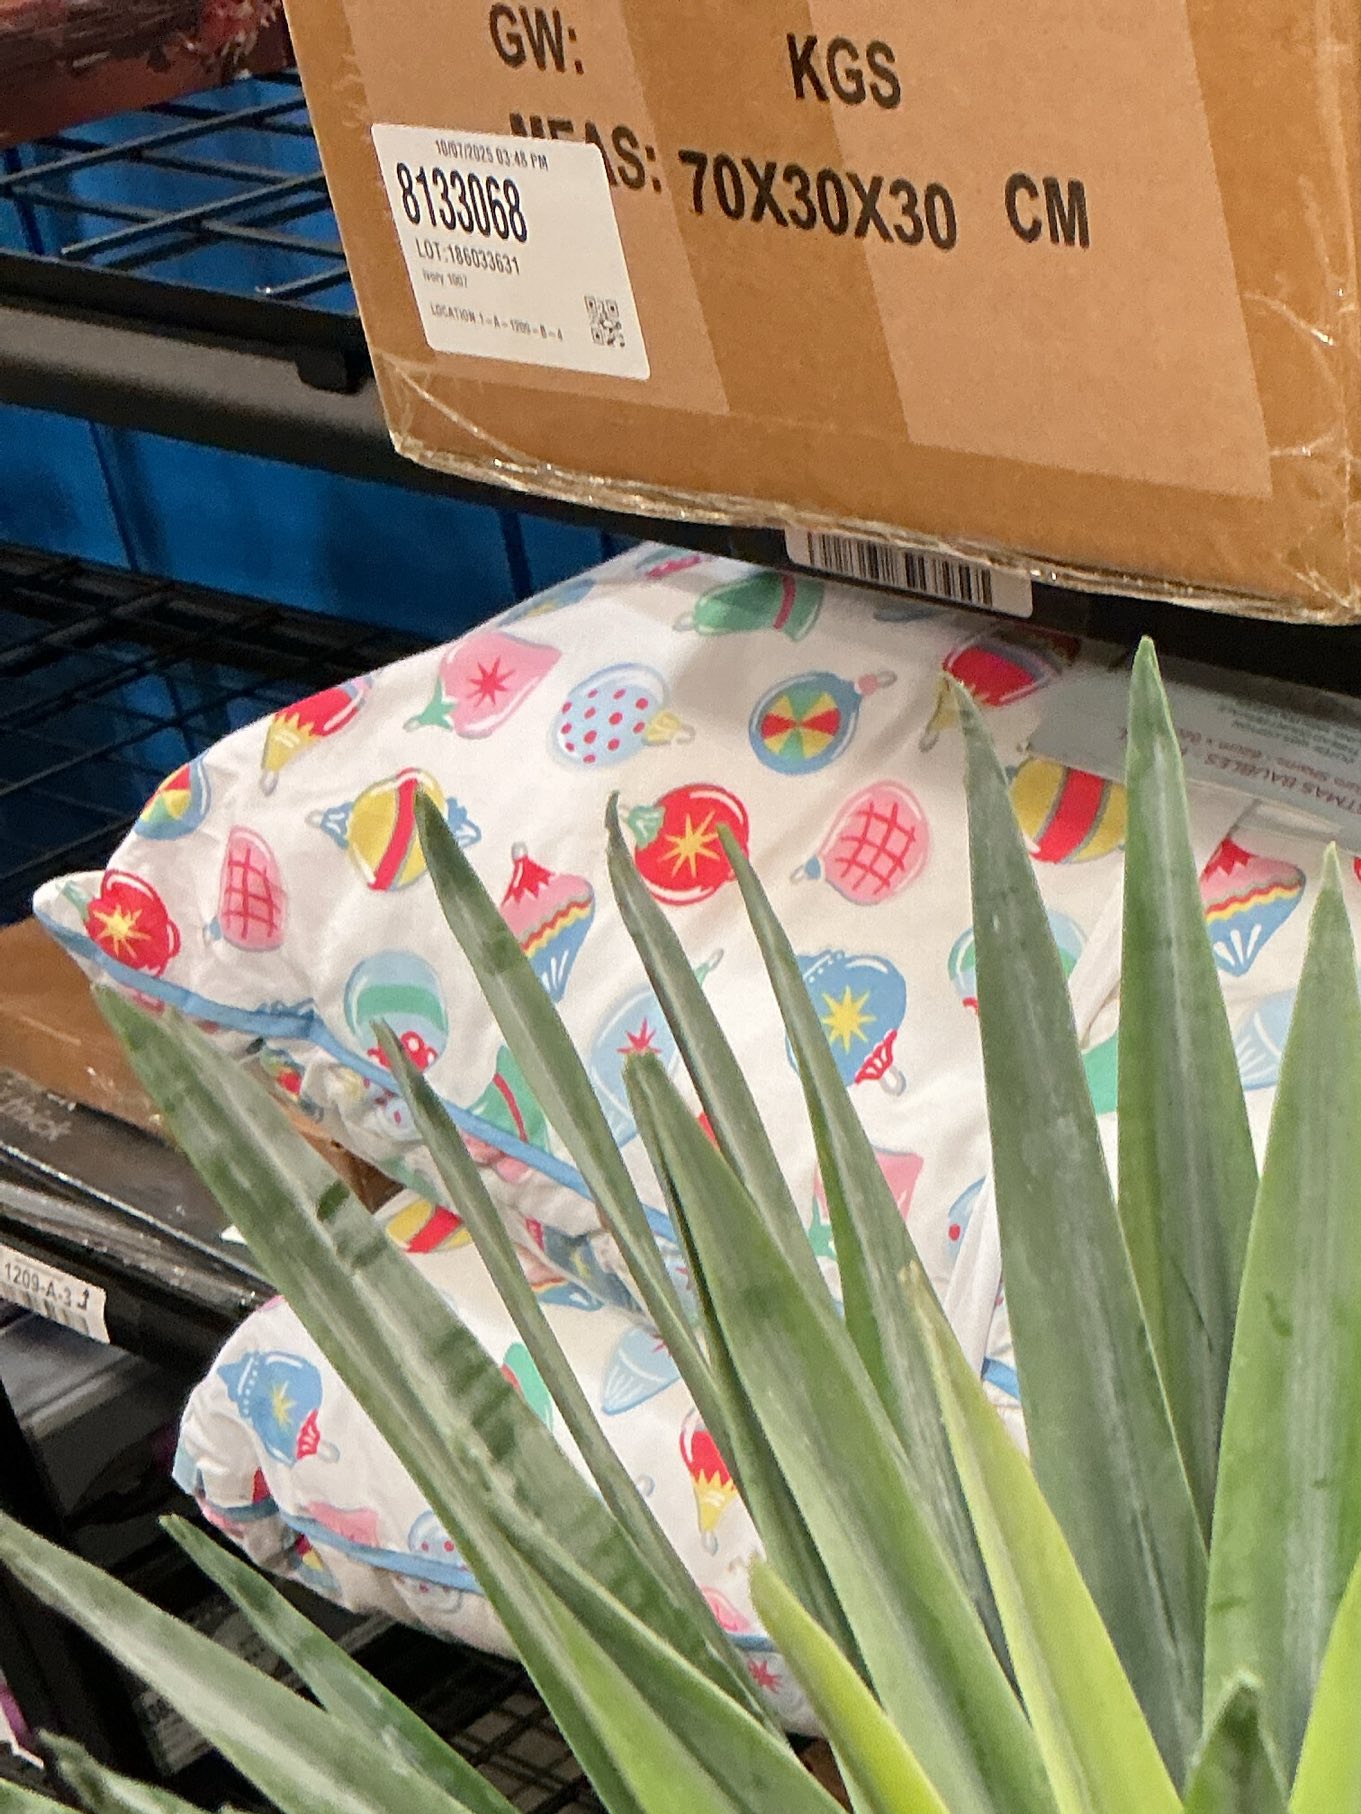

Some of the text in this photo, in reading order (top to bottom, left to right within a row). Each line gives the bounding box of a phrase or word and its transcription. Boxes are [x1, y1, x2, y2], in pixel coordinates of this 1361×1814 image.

[488, 1, 584, 75] GW:
[785, 32, 902, 109] KGS
[435, 139, 494, 164] 10/07/2025
[530, 153, 549, 171] PM
[396, 162, 528, 243] 8133068
[678, 149, 958, 251] 70X30X30
[1005, 172, 1091, 249] CM
